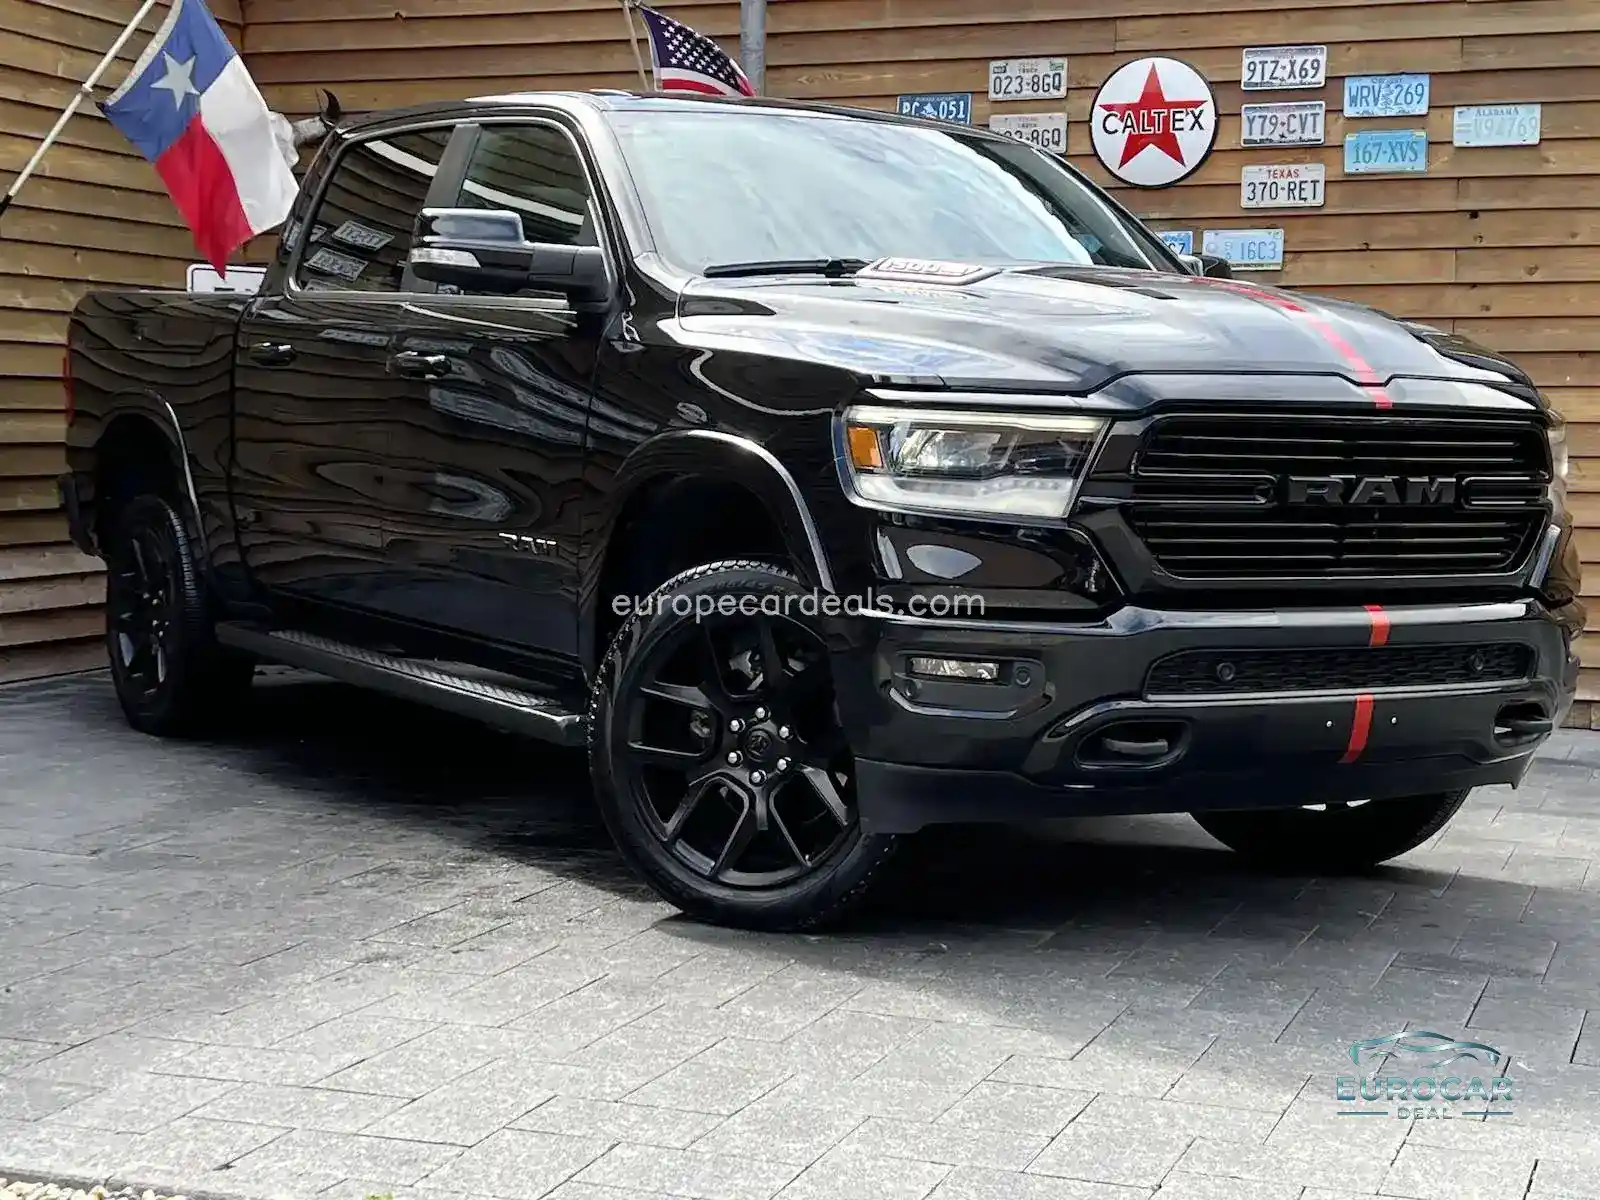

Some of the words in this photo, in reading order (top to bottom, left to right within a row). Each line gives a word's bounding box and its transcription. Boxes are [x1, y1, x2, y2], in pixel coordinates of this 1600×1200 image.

[1102, 109, 1205, 135] CALTEX
[1266, 168, 1301, 179] TEXAS
[1288, 475, 1457, 505] RAM
